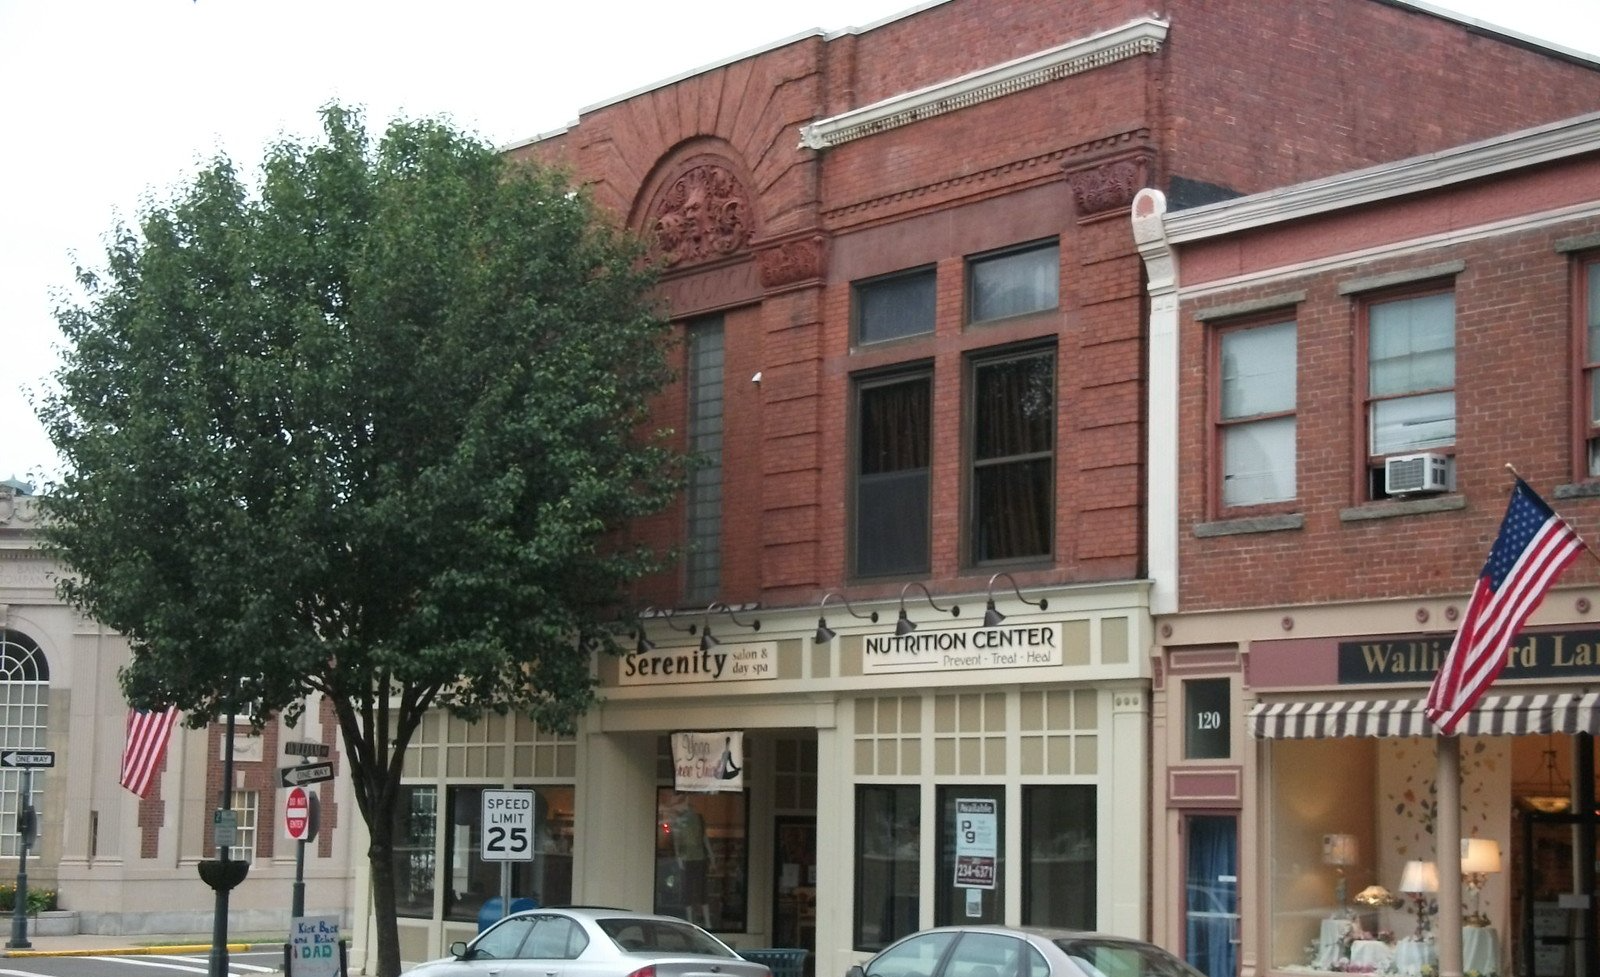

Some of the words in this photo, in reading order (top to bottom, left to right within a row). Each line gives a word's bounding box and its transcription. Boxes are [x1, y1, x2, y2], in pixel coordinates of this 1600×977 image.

[866, 632, 966, 655] NUTRITION
[972, 627, 1056, 649] CENTER
[732, 648, 757, 661] salon
[760, 647, 768, 659] &
[943, 654, 982, 667] Prevent
[992, 652, 1017, 665] Treat
[1027, 650, 1051, 663] Heal
[1361, 636, 1538, 674] Wallird
[1551, 634, 1600, 667] La
[625, 650, 728, 679] Serenity
[732, 661, 748, 676] day
[752, 662, 768, 675] spa
[1198, 711, 1221, 729] 120
[16, 755, 31, 763] ONE
[33, 755, 49, 763] WAY
[297, 771, 311, 779] ONE
[315, 768, 328, 776] WAY
[289, 797, 296, 806] DO
[297, 797, 306, 806] NOT
[487, 798, 530, 810] SPEED
[289, 819, 304, 829] ENTER
[491, 813, 524, 823] LIMIT
[487, 826, 528, 853] 25
[302, 945, 333, 959] DAD
